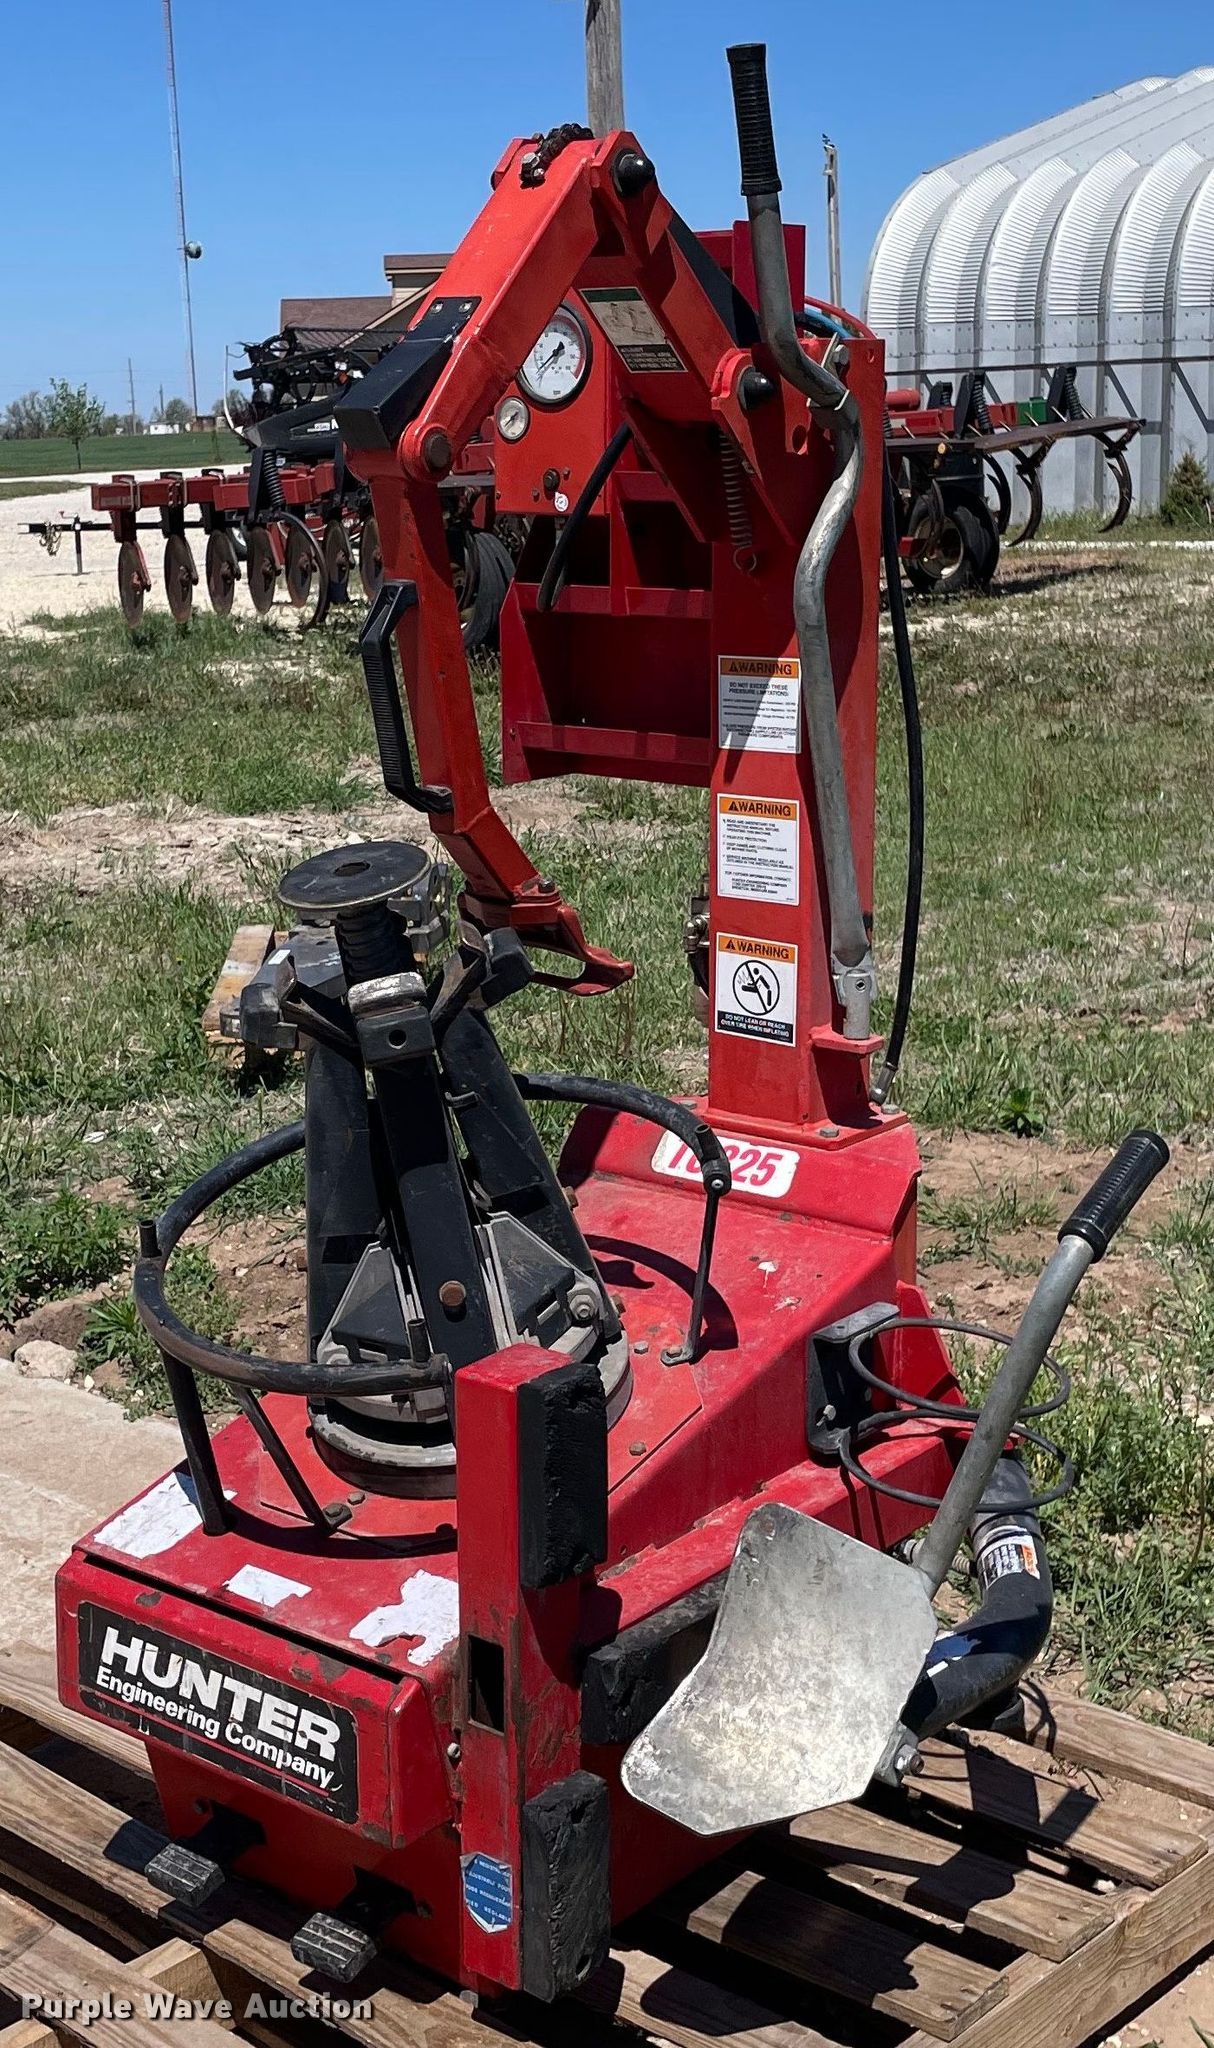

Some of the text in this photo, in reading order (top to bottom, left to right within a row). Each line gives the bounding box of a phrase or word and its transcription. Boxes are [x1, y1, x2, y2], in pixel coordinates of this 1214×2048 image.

[737, 662, 792, 675] WARNING
[738, 801, 791, 816] WARNING
[737, 940, 789, 959] WARNING
[763, 1027, 789, 1037] INFLATING
[100, 1627, 340, 1761] HUNTER
[96, 1666, 335, 1789] Engineering Company
